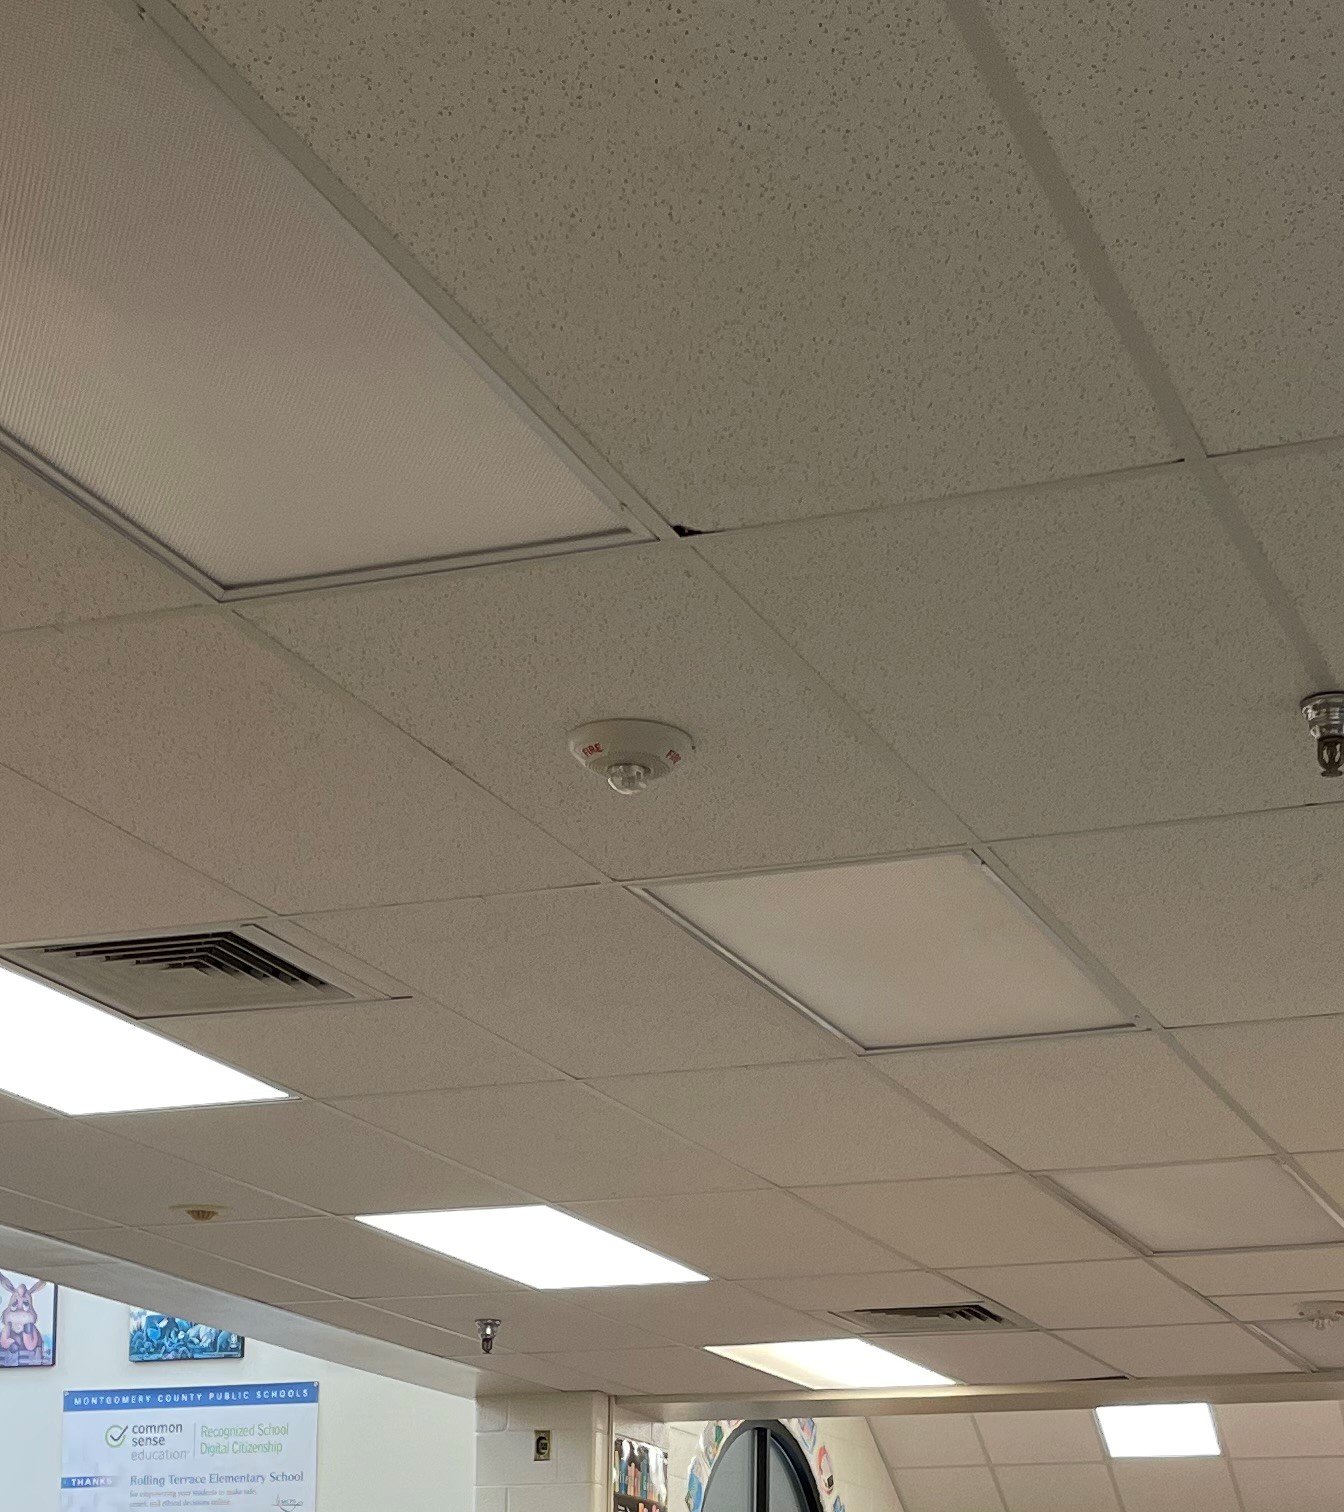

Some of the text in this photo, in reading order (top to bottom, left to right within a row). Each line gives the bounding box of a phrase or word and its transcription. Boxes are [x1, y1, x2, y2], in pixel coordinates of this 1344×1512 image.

[73, 1389, 309, 1406] MONTGOMERY COUNTY PUBLIC SCHOOLS
[131, 1423, 183, 1434] common
[200, 1422, 290, 1439] Recognized School
[131, 1436, 166, 1447] sense
[200, 1440, 284, 1457] Digital Citizenship
[131, 1448, 188, 1462] education
[71, 1476, 114, 1487] THANKS
[130, 1471, 304, 1488] Rolling Terrace Elementary School
